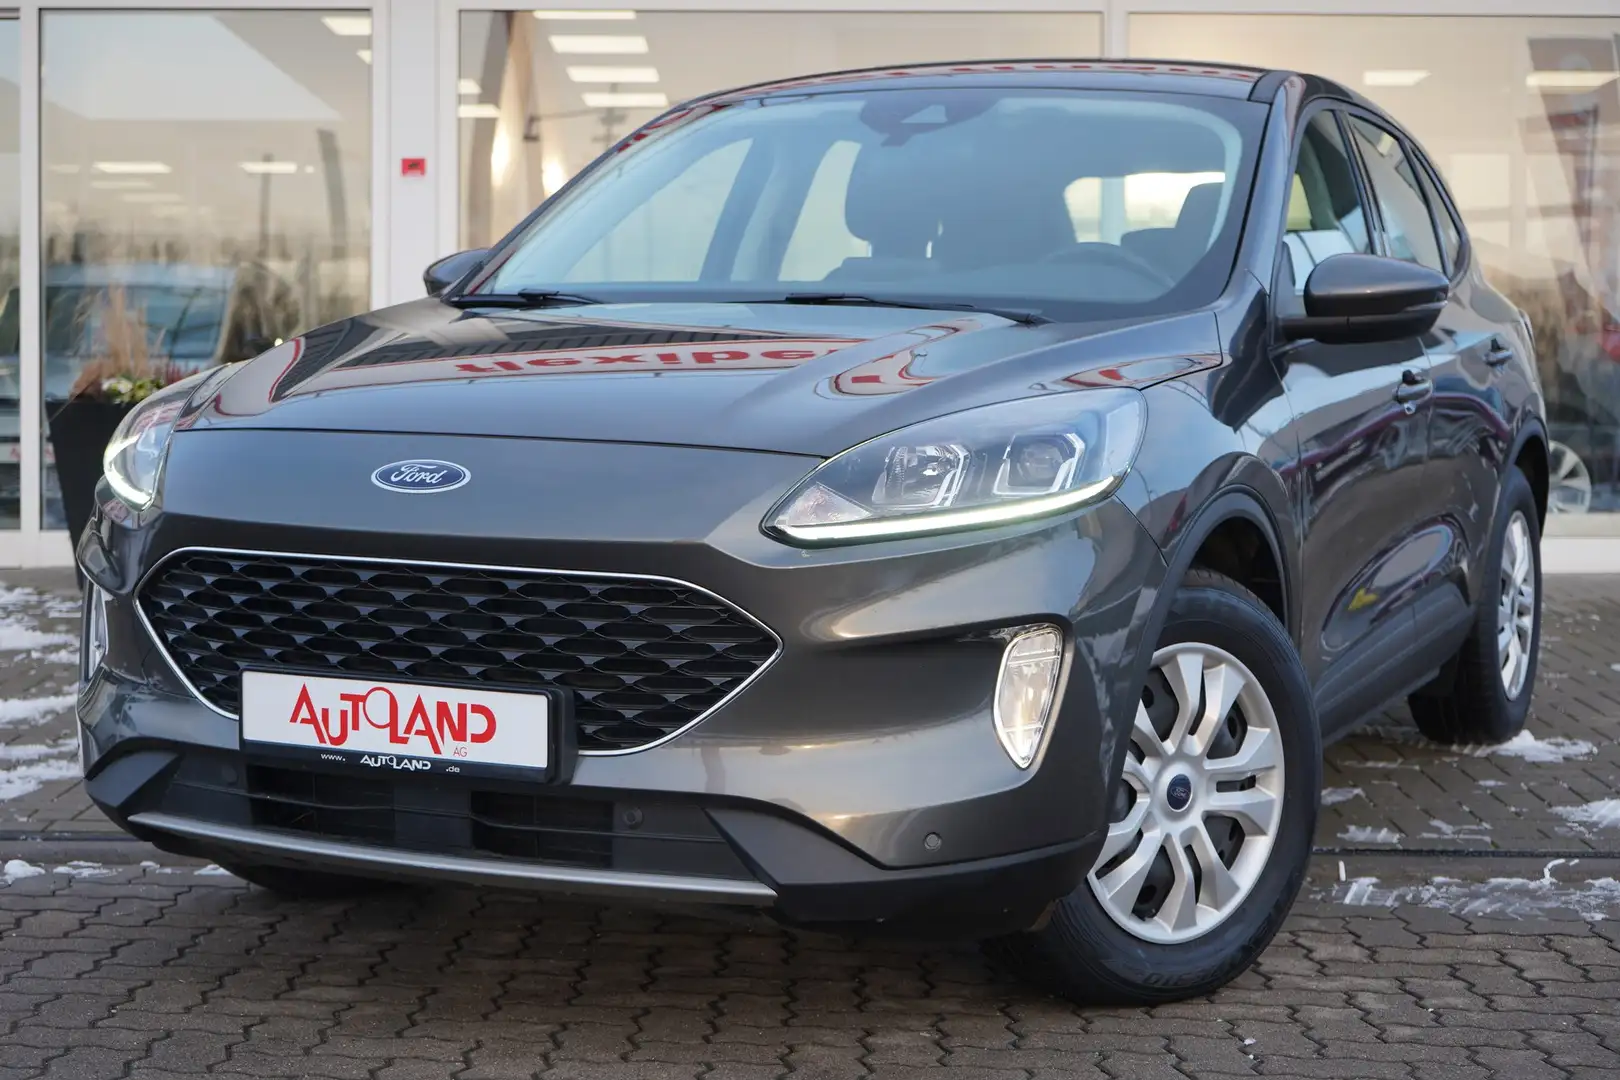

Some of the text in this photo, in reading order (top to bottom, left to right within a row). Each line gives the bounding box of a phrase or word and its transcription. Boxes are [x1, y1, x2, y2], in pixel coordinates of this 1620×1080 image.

[390, 463, 448, 484] Ford
[452, 745, 469, 758] AG
[320, 752, 346, 762] www.
[445, 765, 461, 773] .de
